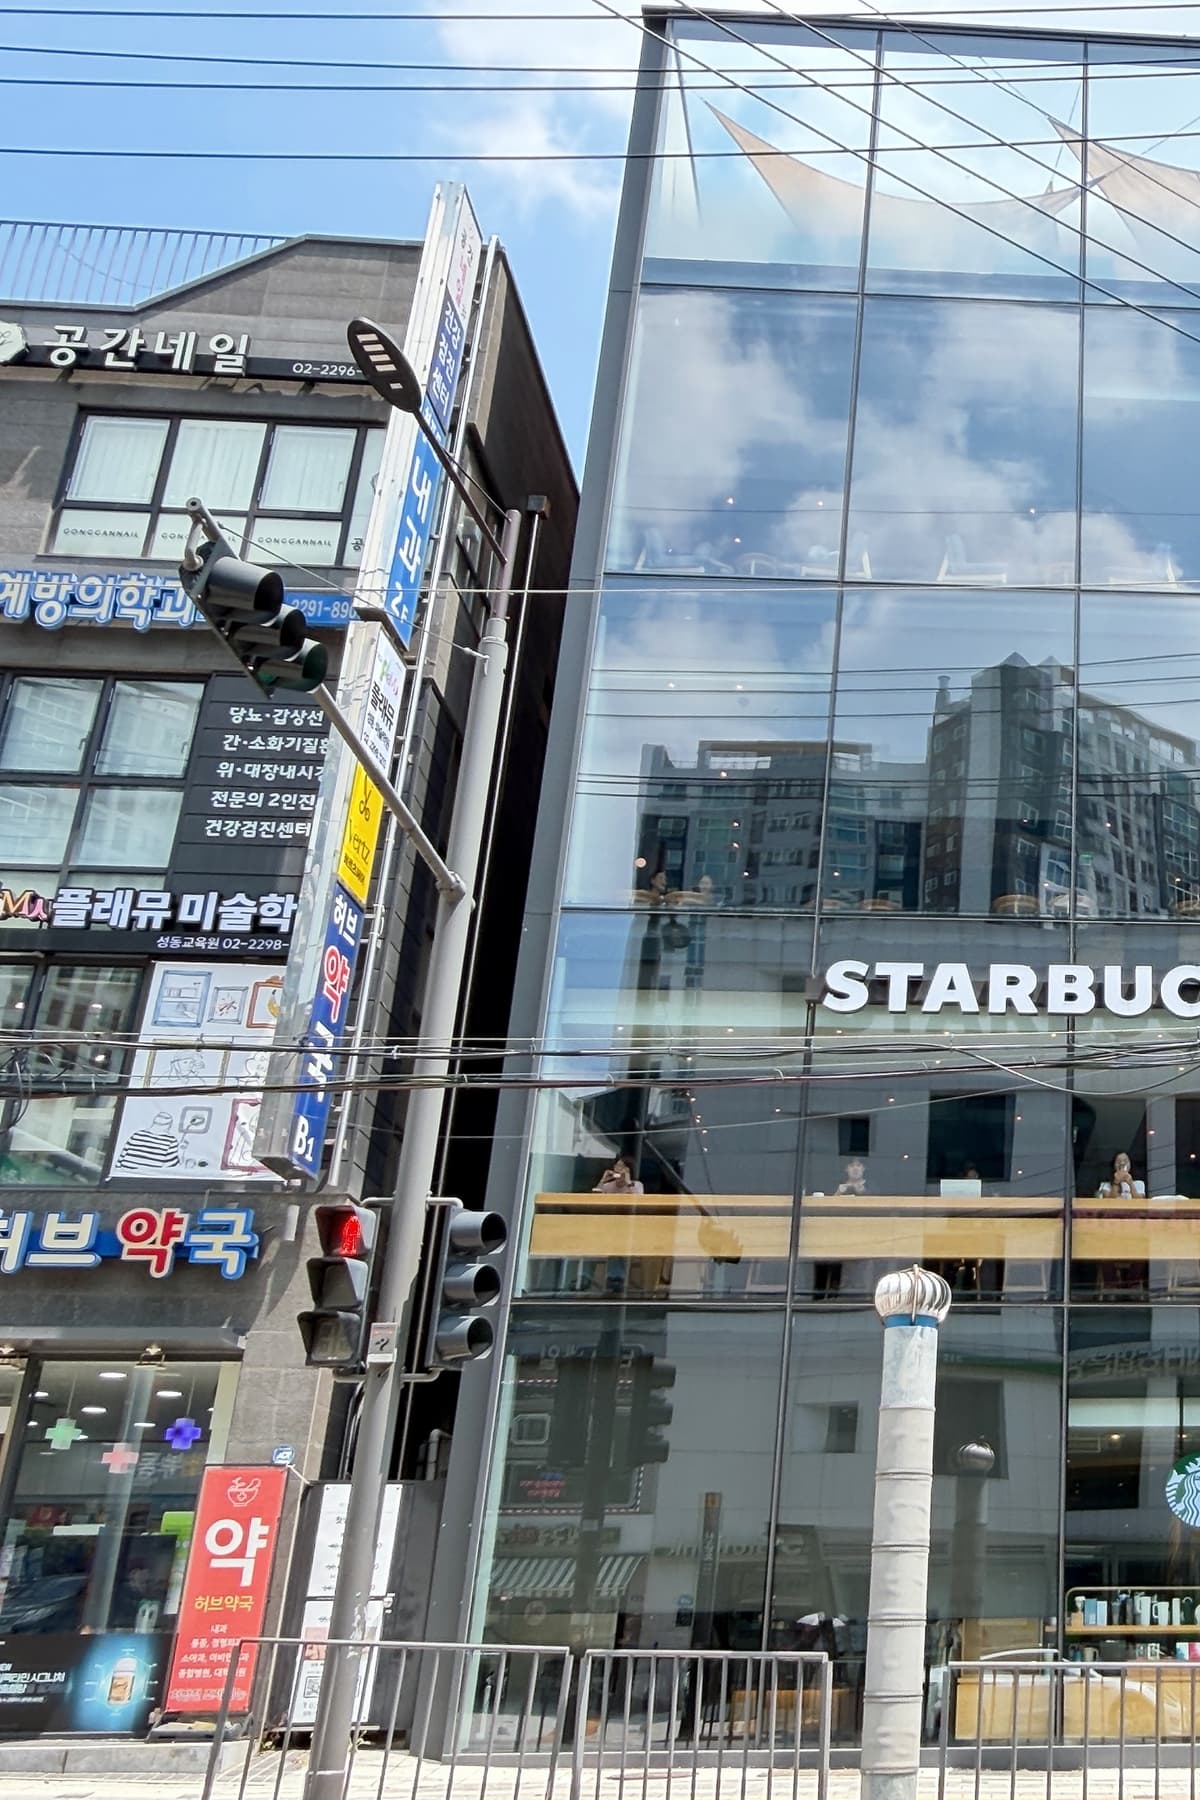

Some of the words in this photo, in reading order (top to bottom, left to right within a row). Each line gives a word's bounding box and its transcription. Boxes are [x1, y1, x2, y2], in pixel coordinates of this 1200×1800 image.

[445, 301, 461, 350] 건강
[44, 326, 250, 375] 공간네일
[438, 333, 455, 383] 검진
[432, 366, 450, 417] 센터
[399, 455, 432, 584] 내과
[229, 706, 324, 727] 당뇨·갑상선
[210, 790, 264, 809] 전문의
[205, 819, 313, 839] 건강검진센터
[52, 887, 173, 931] 플래뮤
[177, 890, 299, 935] 미술학
[333, 894, 358, 946] 허브
[156, 936, 220, 951] 성동교육원
[293, 1113, 315, 1164] B1
[205, 1517, 270, 1587] 약
[195, 1596, 254, 1612] 허브약국
